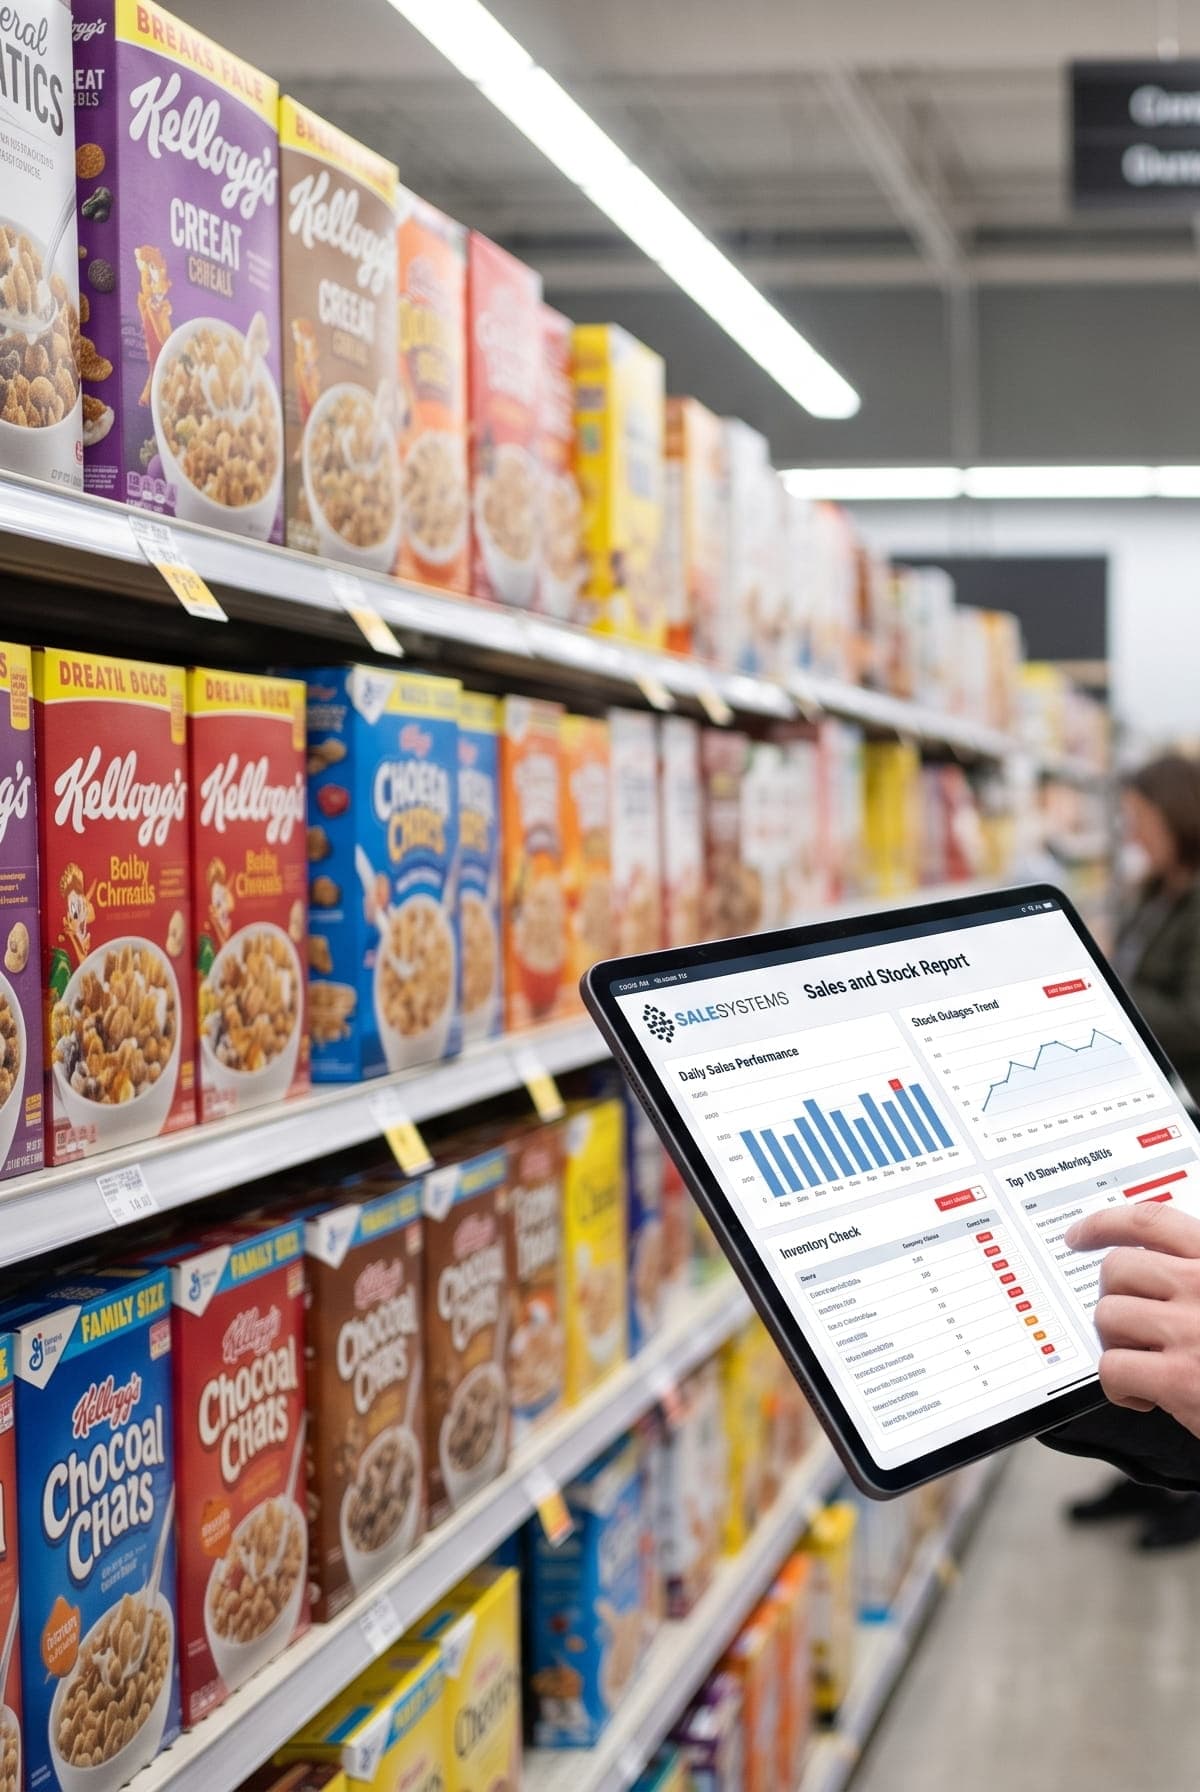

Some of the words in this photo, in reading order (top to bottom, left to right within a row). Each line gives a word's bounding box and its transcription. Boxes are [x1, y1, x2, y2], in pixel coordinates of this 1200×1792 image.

[54, 745, 187, 847] Kellogg's
[803, 980, 847, 999] Sales
[848, 970, 878, 990] and
[876, 962, 921, 984] Stock
[919, 953, 970, 976] Report
[674, 991, 790, 1027] SALESYSTEMS
[937, 1007, 974, 1021] Outages
[972, 999, 1000, 1012] Trend
[678, 1066, 707, 1082] Daily
[706, 1060, 736, 1075] Sales
[734, 1047, 800, 1069] Performance
[1005, 1176, 1025, 1189] Top
[1023, 1170, 1037, 1183] 10
[779, 1237, 829, 1260] Inventory
[828, 1225, 862, 1245] Check
[81, 1295, 135, 1345] FAMILY
[136, 1281, 165, 1319] SIZE
[199, 1333, 299, 1447] Chocoal
[43, 1404, 165, 1541] Chocoal
